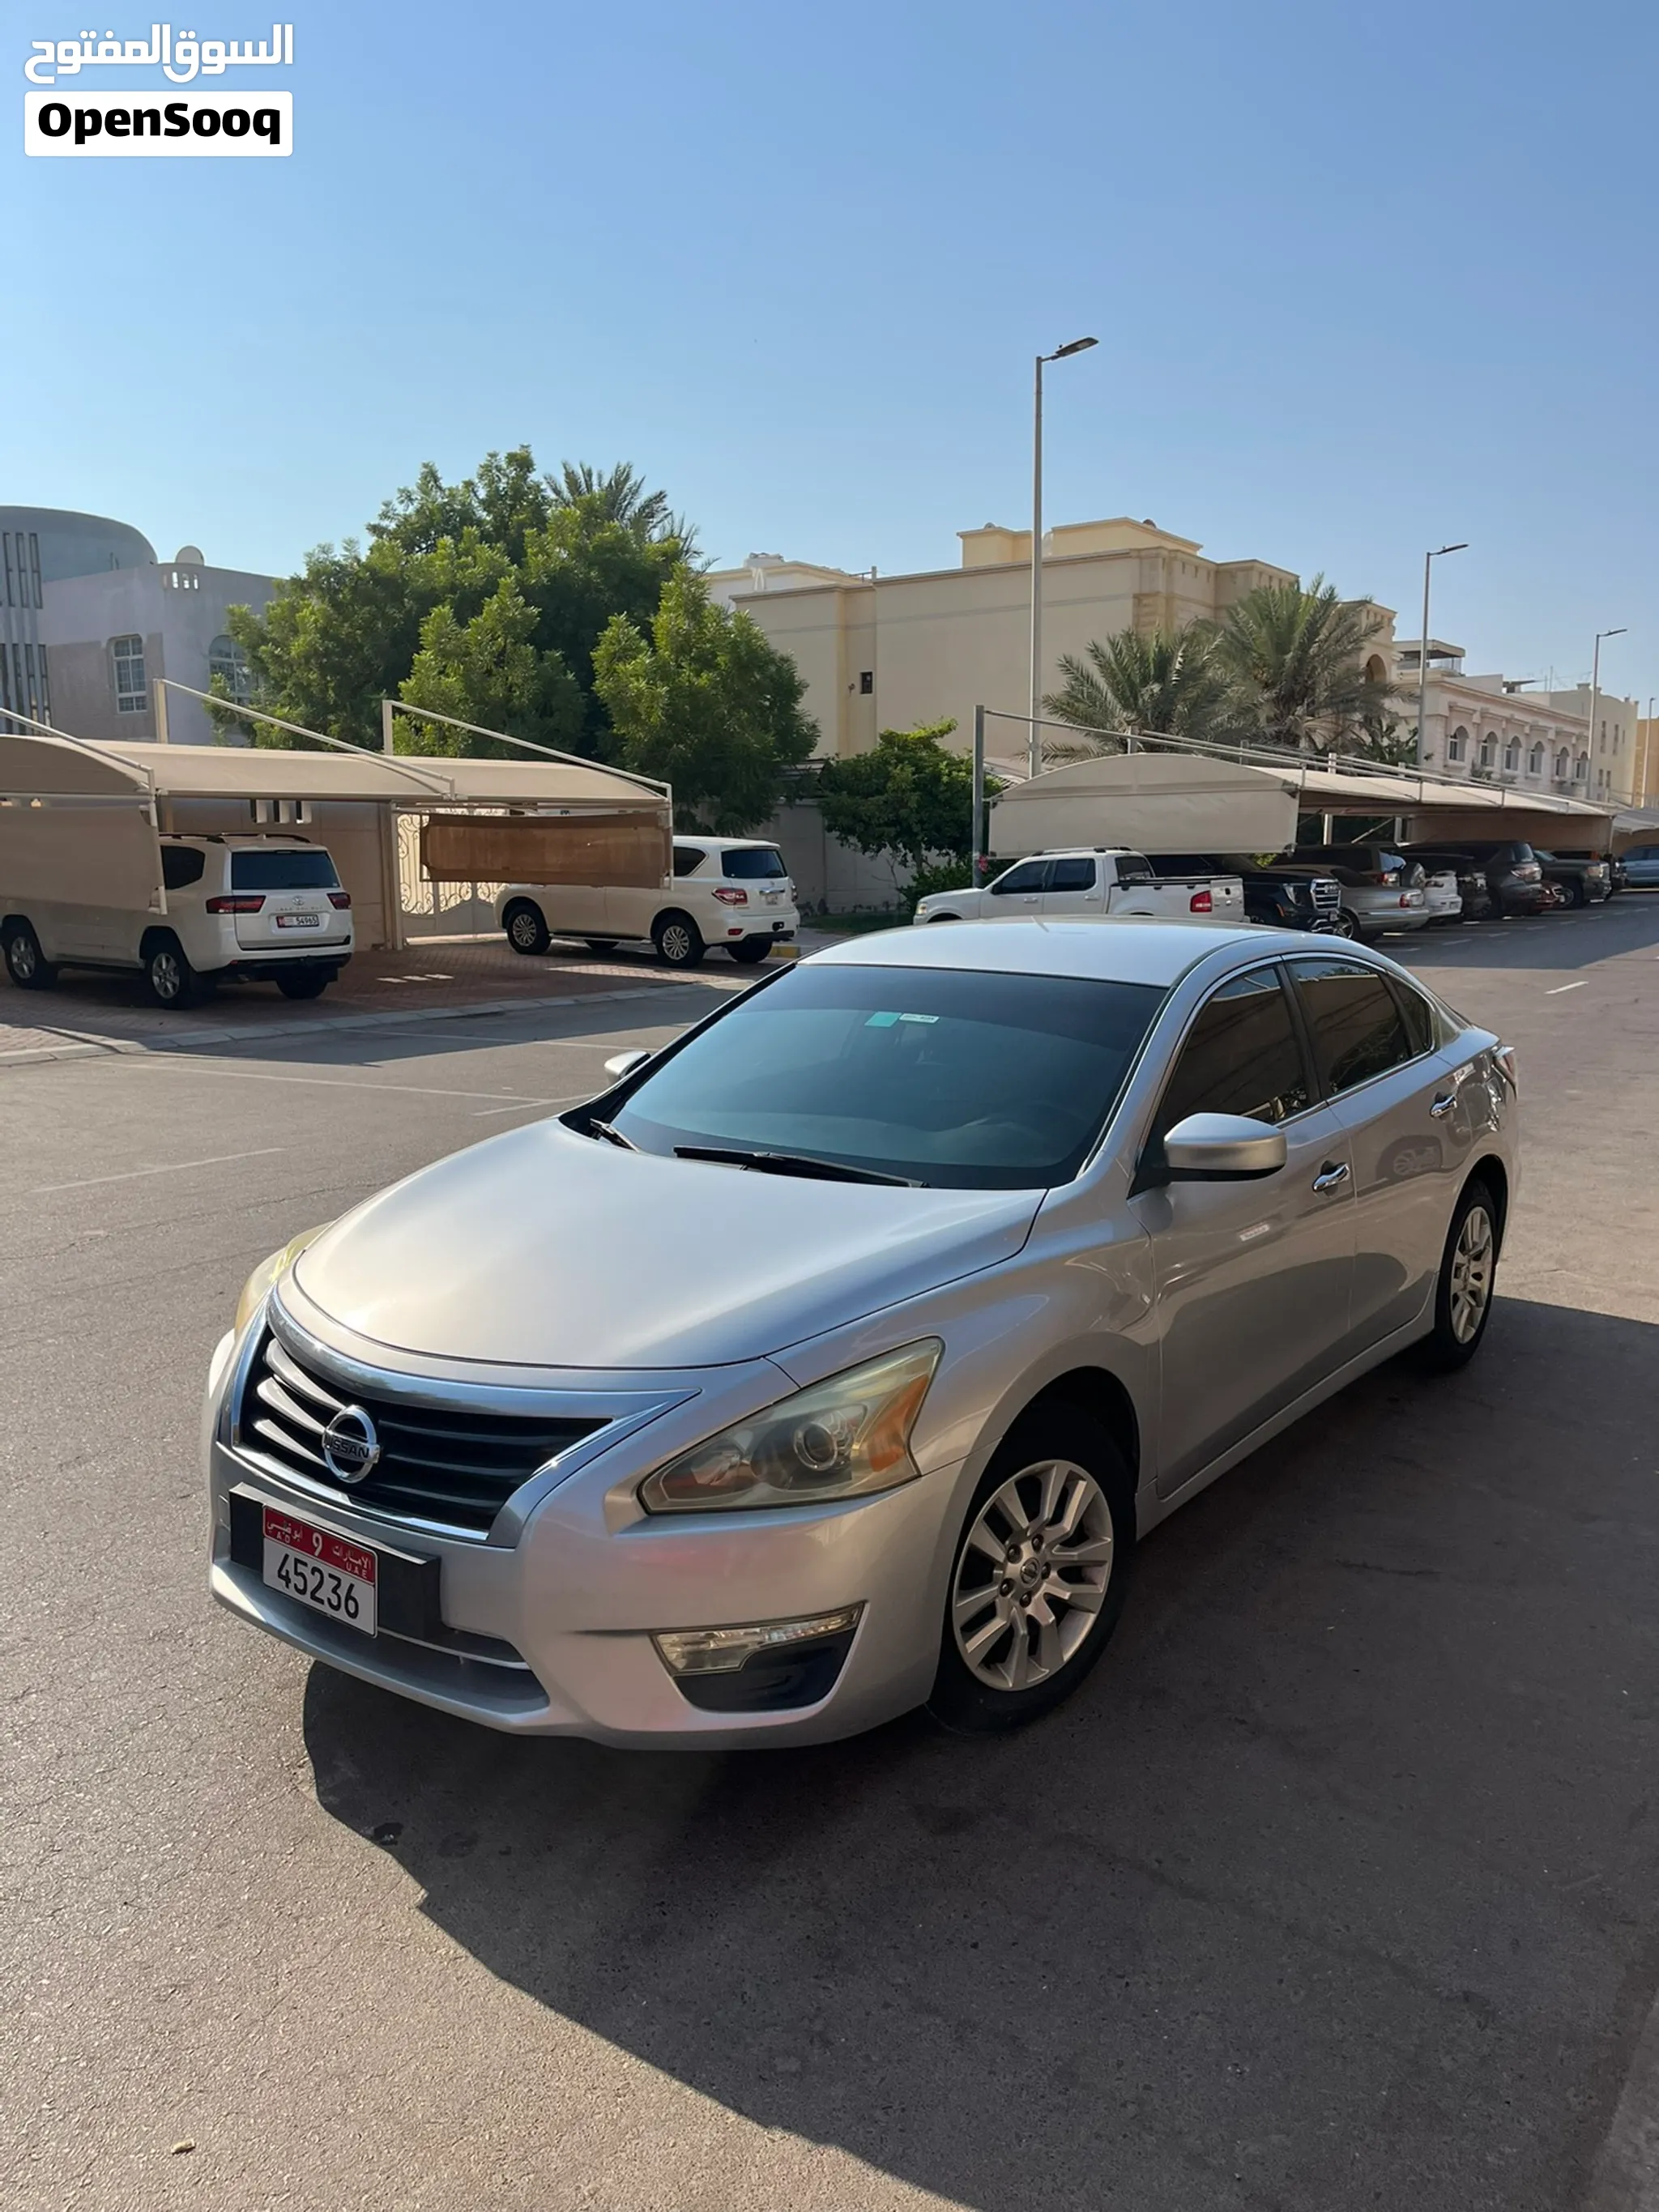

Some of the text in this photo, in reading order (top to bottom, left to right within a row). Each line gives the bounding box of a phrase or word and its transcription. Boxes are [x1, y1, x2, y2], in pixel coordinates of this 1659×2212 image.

[325, 1432, 370, 1459] NISSAN
[312, 1532, 322, 1557] 9
[277, 1553, 359, 1619] 45236
